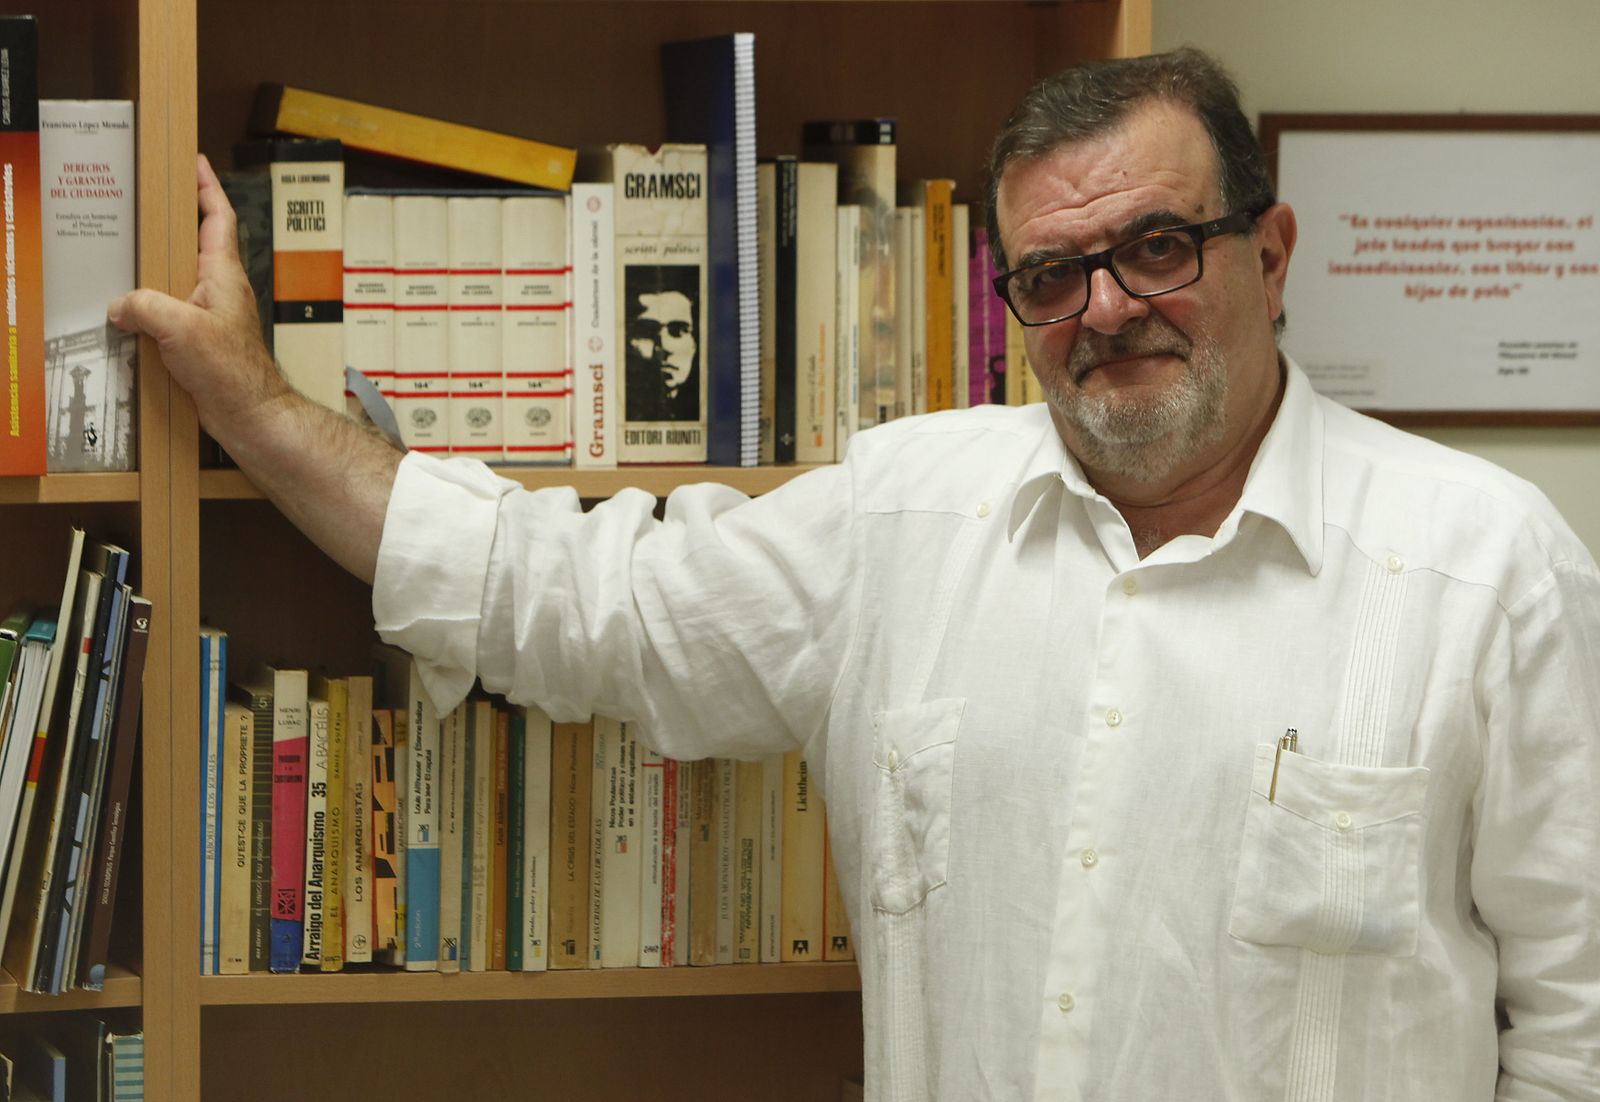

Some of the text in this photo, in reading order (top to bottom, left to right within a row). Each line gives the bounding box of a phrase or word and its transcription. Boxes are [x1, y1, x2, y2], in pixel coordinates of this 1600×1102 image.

[42, 120, 77, 129] Francisco
[64, 163, 110, 172] DERECHOS
[58, 176, 64, 185] Y
[624, 172, 701, 199] GRAMSCI
[50, 189, 123, 198] DEL CIUDADANO
[287, 200, 324, 215] SCRITTI
[287, 217, 325, 232] POLITICI
[1452, 240, 1480, 254] que
[1545, 240, 1574, 252] con
[1471, 263, 1500, 274] con
[1570, 263, 1599, 274] con
[1448, 283, 1468, 298] de
[10, 383, 19, 437] Asistencia
[589, 364, 604, 458] Gramsci
[624, 429, 700, 445] EDITORI RIUNITI
[238, 780, 247, 791] LA
[312, 782, 326, 798] 35
[609, 767, 617, 806] Poulantzas
[797, 761, 807, 812] Lichtheim
[237, 795, 246, 815] QUE
[355, 783, 363, 872] ANARQUISTAS
[331, 807, 340, 895] ANARQUISMO
[568, 872, 574, 882] LA
[306, 811, 325, 960] Arraigo del Anarquismo
[331, 906, 338, 918] EL
